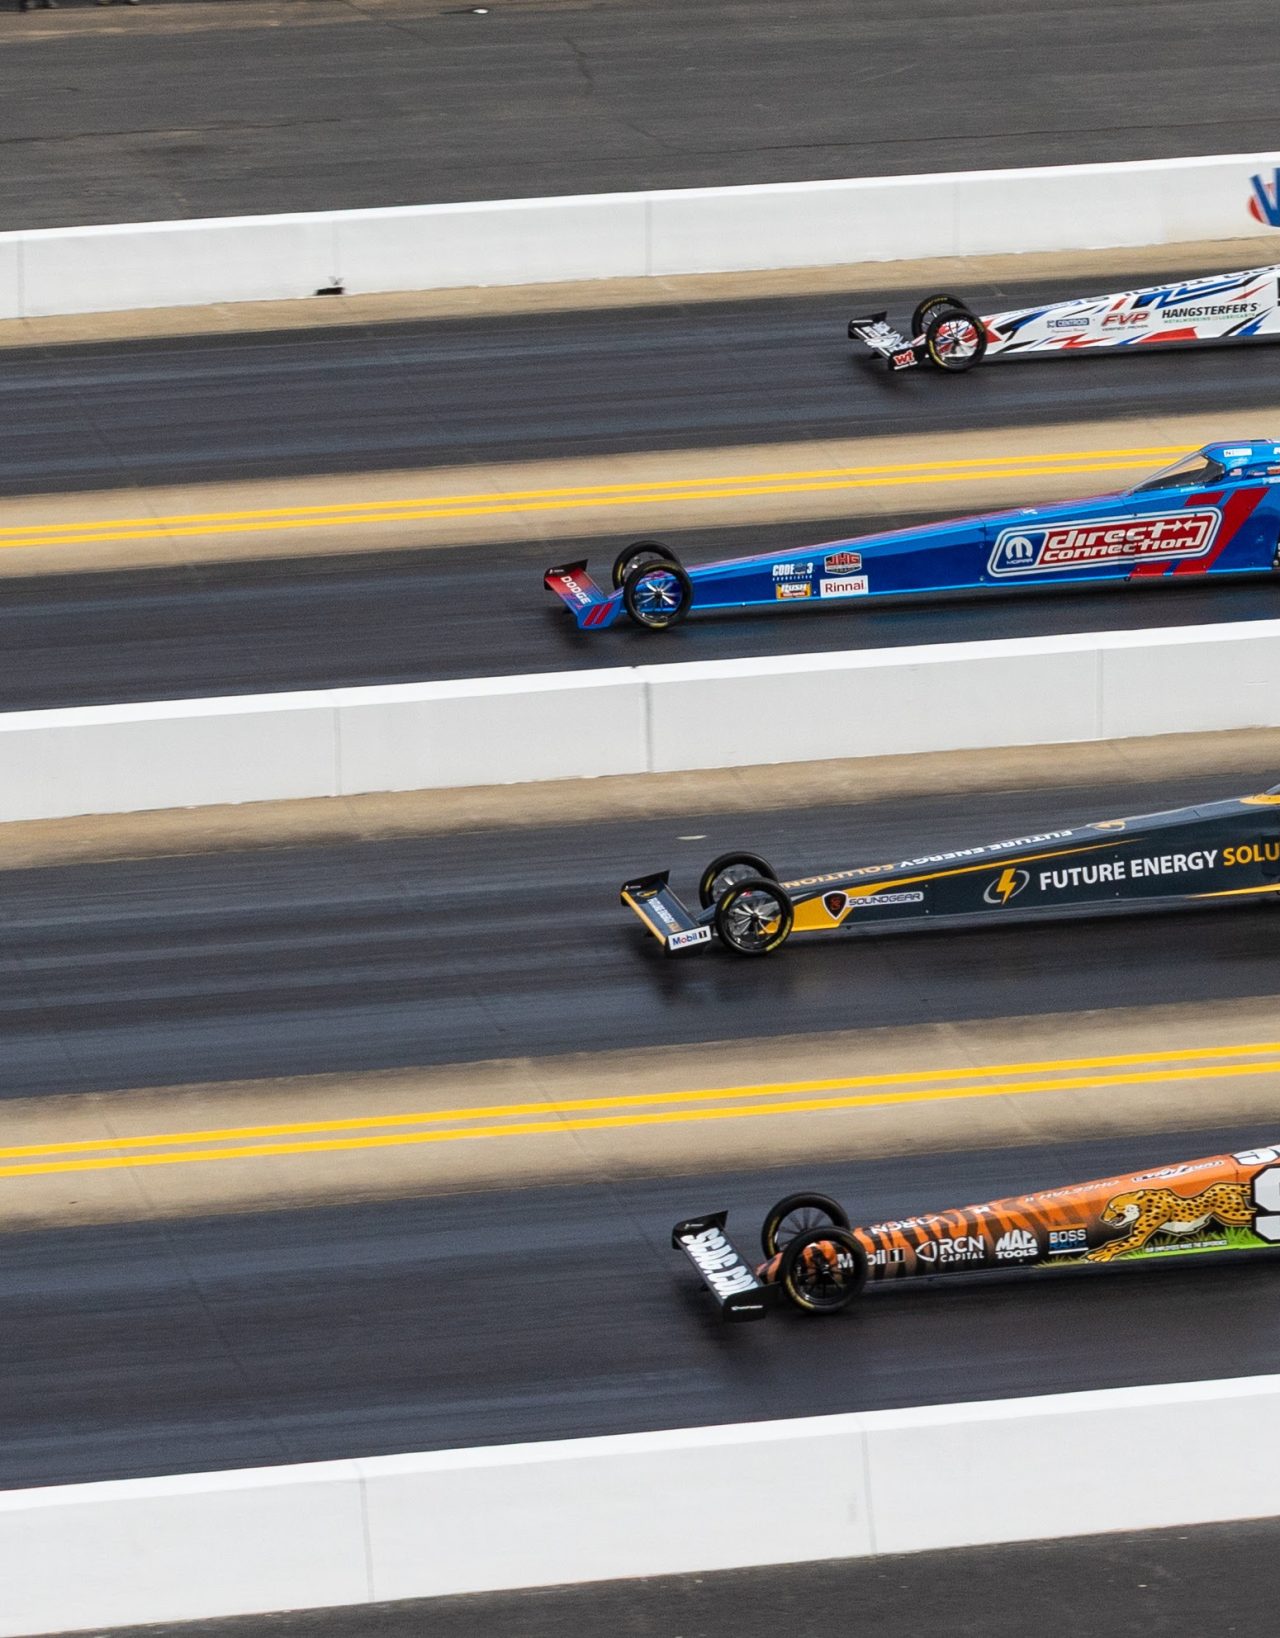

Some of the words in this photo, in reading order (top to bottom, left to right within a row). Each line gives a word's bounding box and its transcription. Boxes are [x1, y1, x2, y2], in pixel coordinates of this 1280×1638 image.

[1101, 312, 1151, 327] FVP
[1161, 302, 1258, 319] HANGSTERFER'S
[1049, 521, 1174, 549] direct
[1043, 537, 1202, 562] connection
[772, 563, 795, 577] CODE
[806, 562, 814, 574] 3
[560, 575, 592, 605] DODGE
[825, 579, 865, 593] Rinnai
[989, 829, 1073, 852] FUTURE
[900, 846, 986, 868] ENERGY
[1039, 861, 1126, 891] FUTURE
[1131, 849, 1219, 879] ENERGY
[848, 891, 922, 907] SOUNDGEAR
[672, 932, 698, 946] Mobil
[939, 1235, 985, 1254] RCN
[996, 1229, 1037, 1251] MAC
[1049, 1228, 1087, 1244] BOSS
[837, 1250, 886, 1269] Mbil
[939, 1251, 985, 1263] CAPITAL
[996, 1248, 1039, 1260] TOOLS
